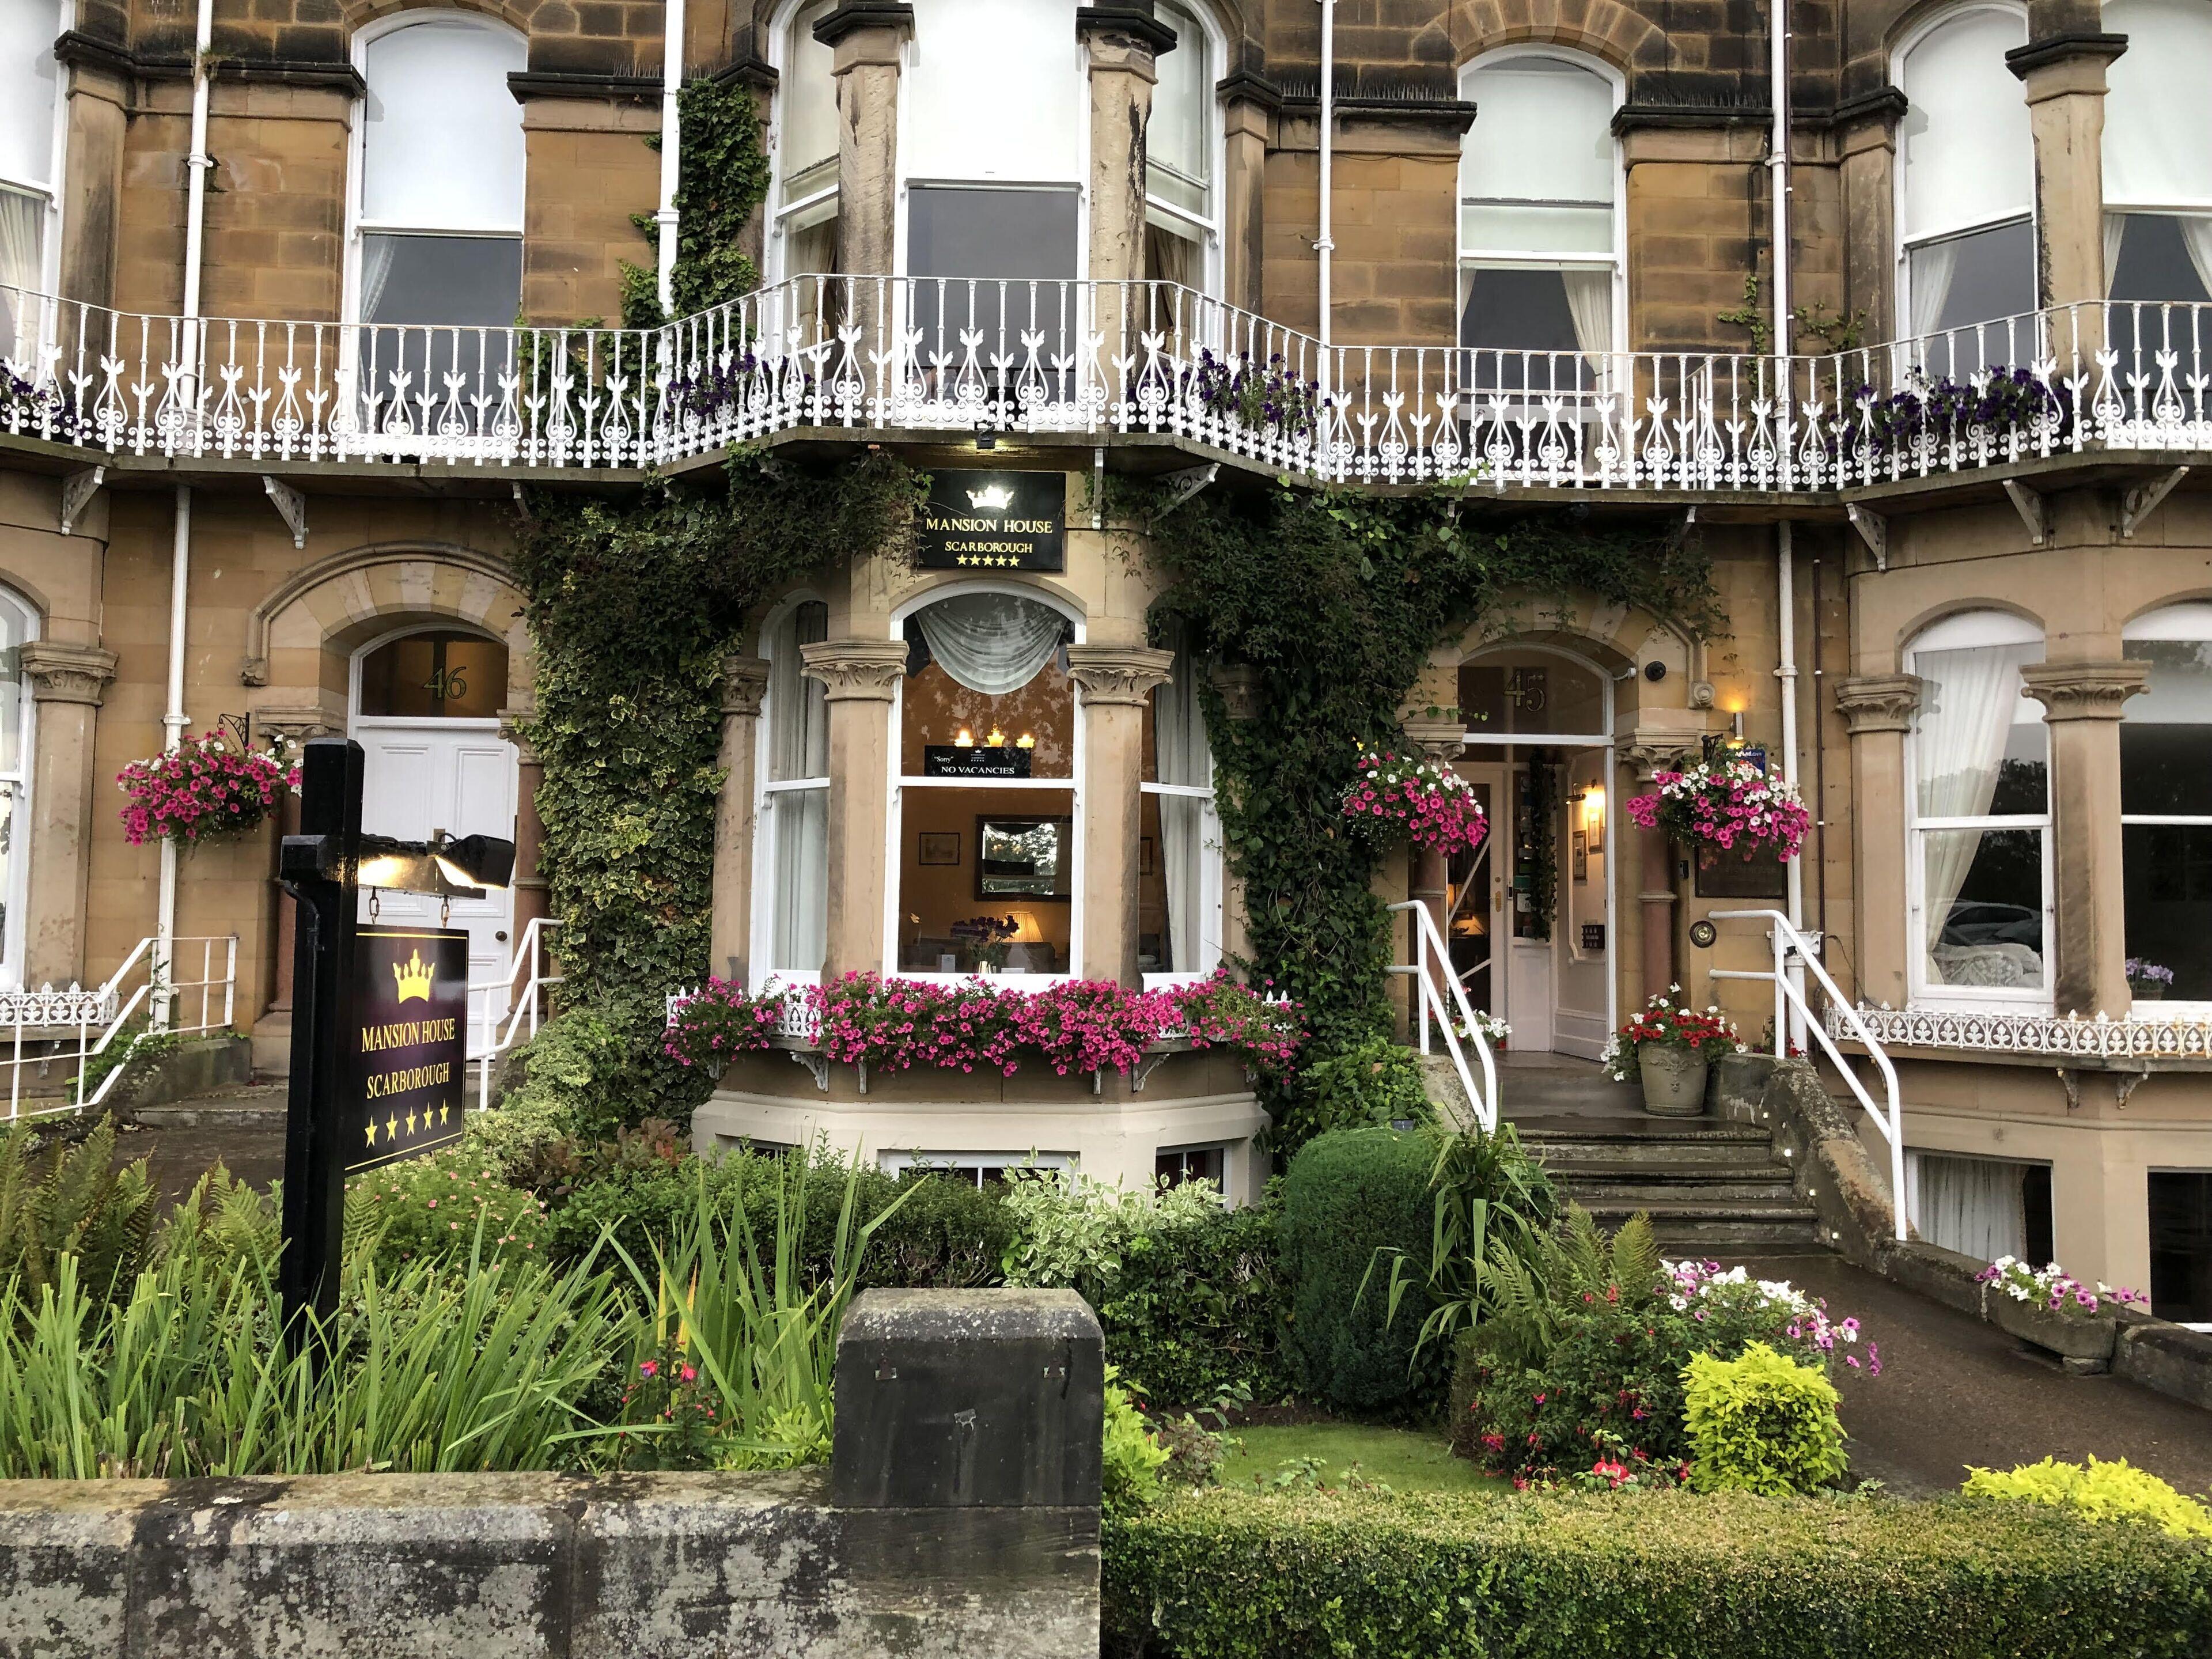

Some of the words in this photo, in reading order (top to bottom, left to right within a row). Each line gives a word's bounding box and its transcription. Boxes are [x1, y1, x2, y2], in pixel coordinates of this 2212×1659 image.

[926, 518, 997, 532] MANSION
[1003, 520, 1053, 533] HOUSE
[945, 541, 1033, 554] SCARBOROUGH
[422, 666, 467, 699] 46
[1503, 671, 1546, 711] 45
[958, 766, 1015, 774] VACANCIES
[361, 1021, 419, 1052] MANSION
[421, 1018, 455, 1045] HOUSE
[366, 1062, 450, 1099] SCARBOROUGH
